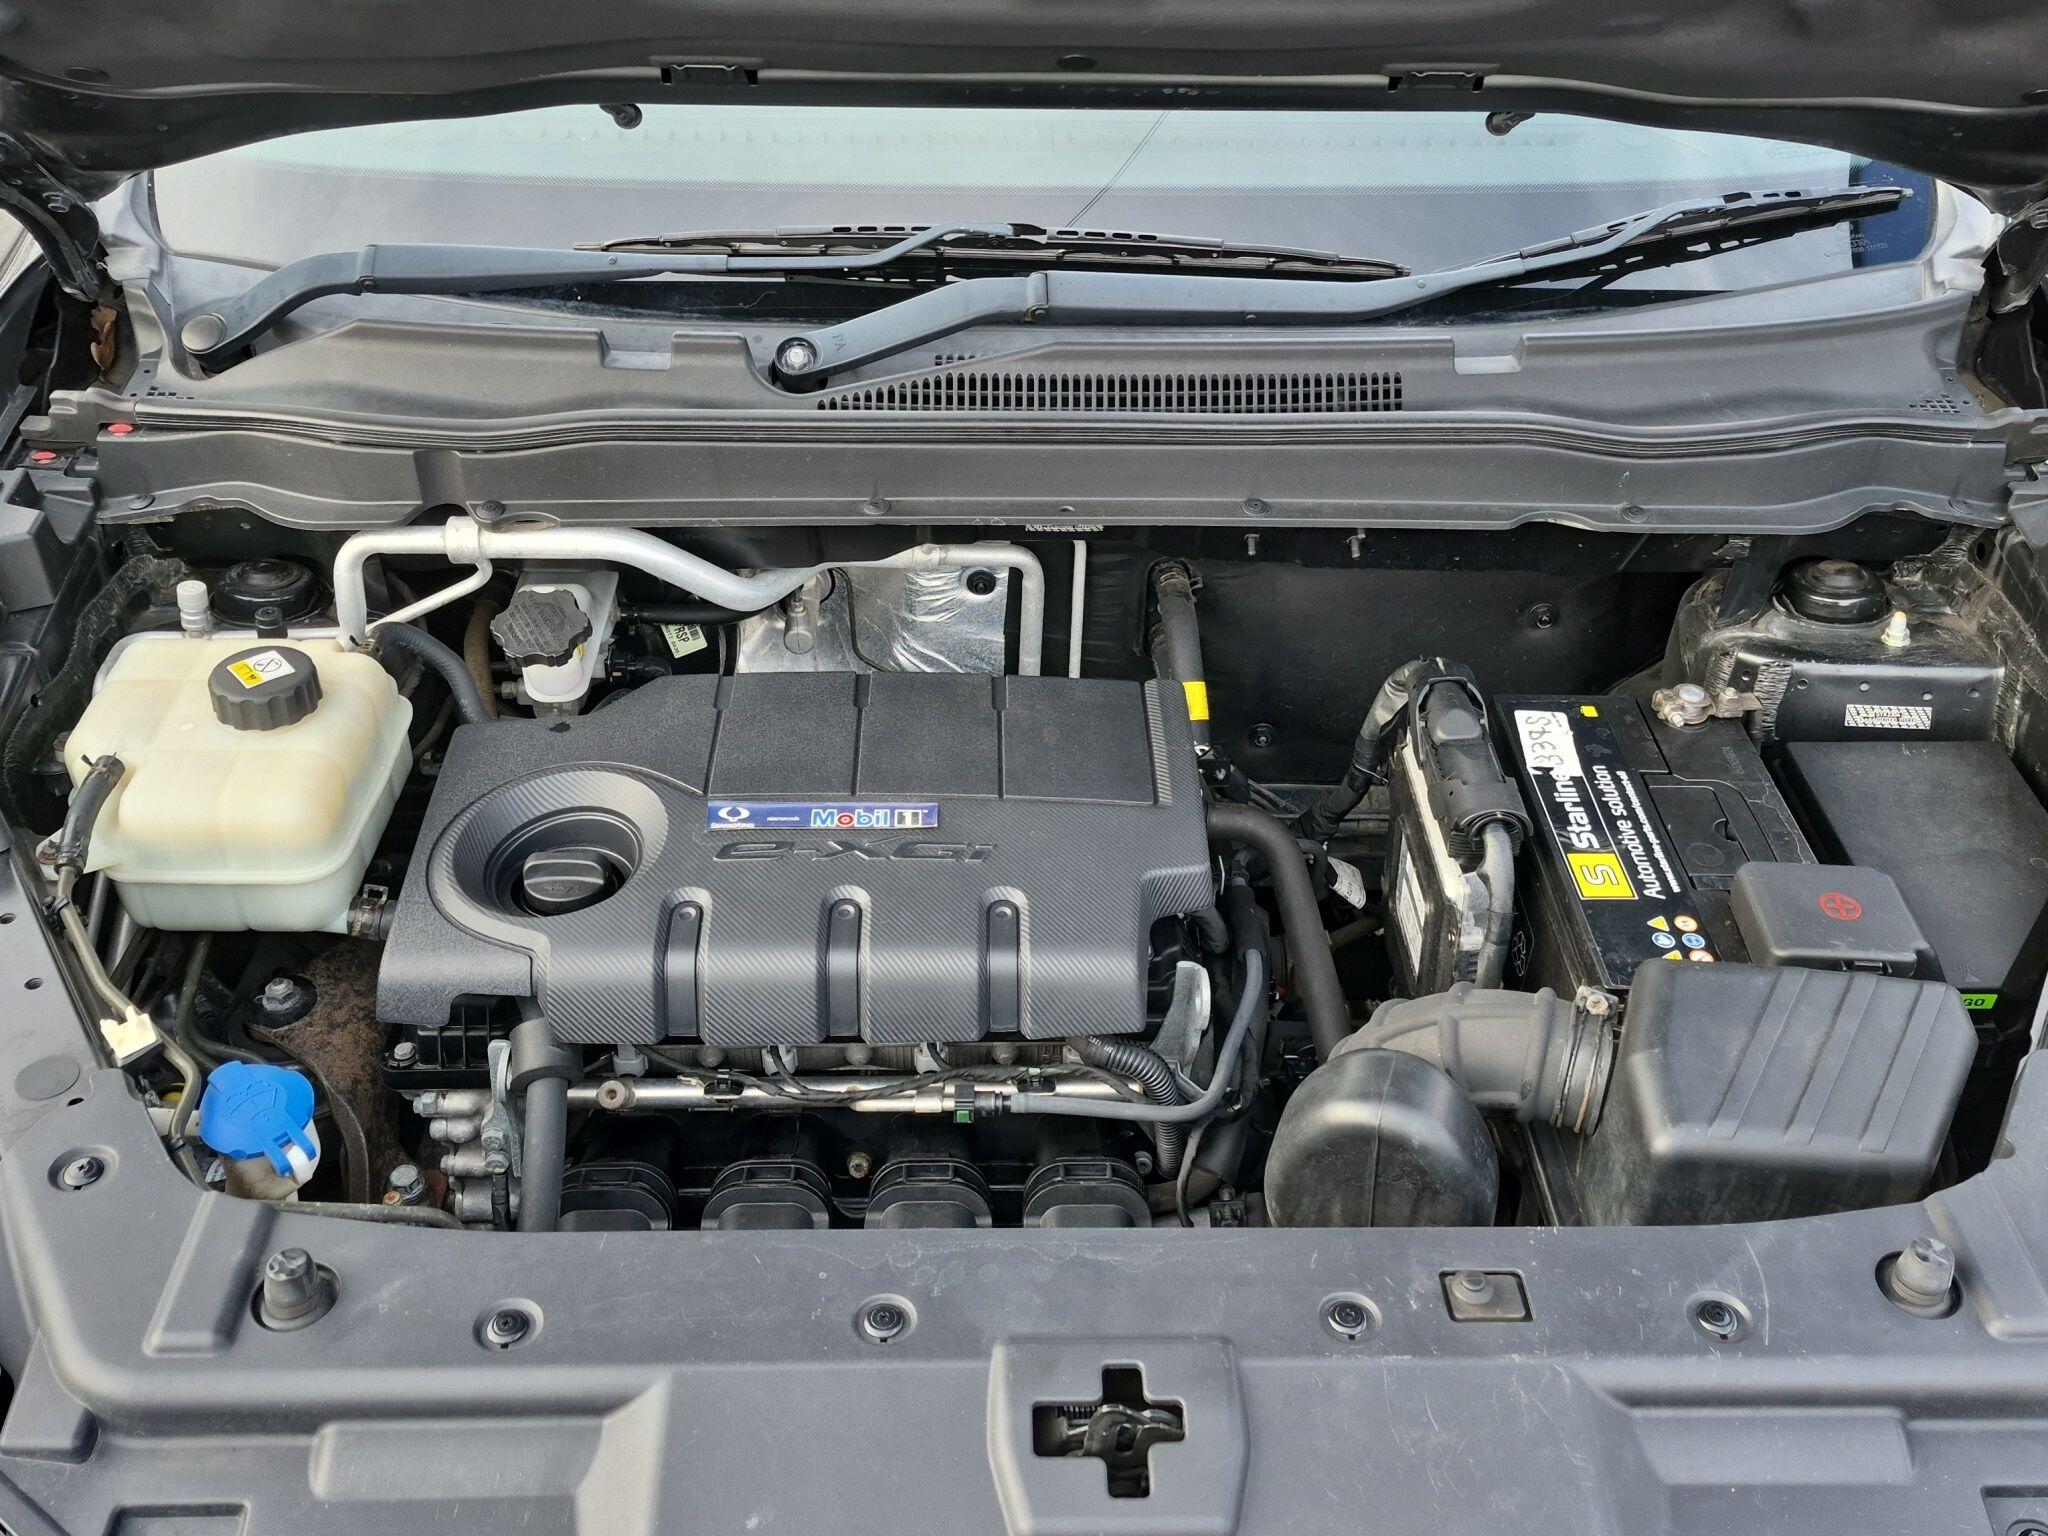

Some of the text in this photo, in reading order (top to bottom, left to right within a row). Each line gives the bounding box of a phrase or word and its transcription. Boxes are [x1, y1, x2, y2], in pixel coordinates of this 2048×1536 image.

[674, 626, 690, 643] RSP
[811, 809, 890, 827] Mobil
[1552, 773, 1619, 886] S Starline
[1592, 765, 1666, 900] Automotive solution
